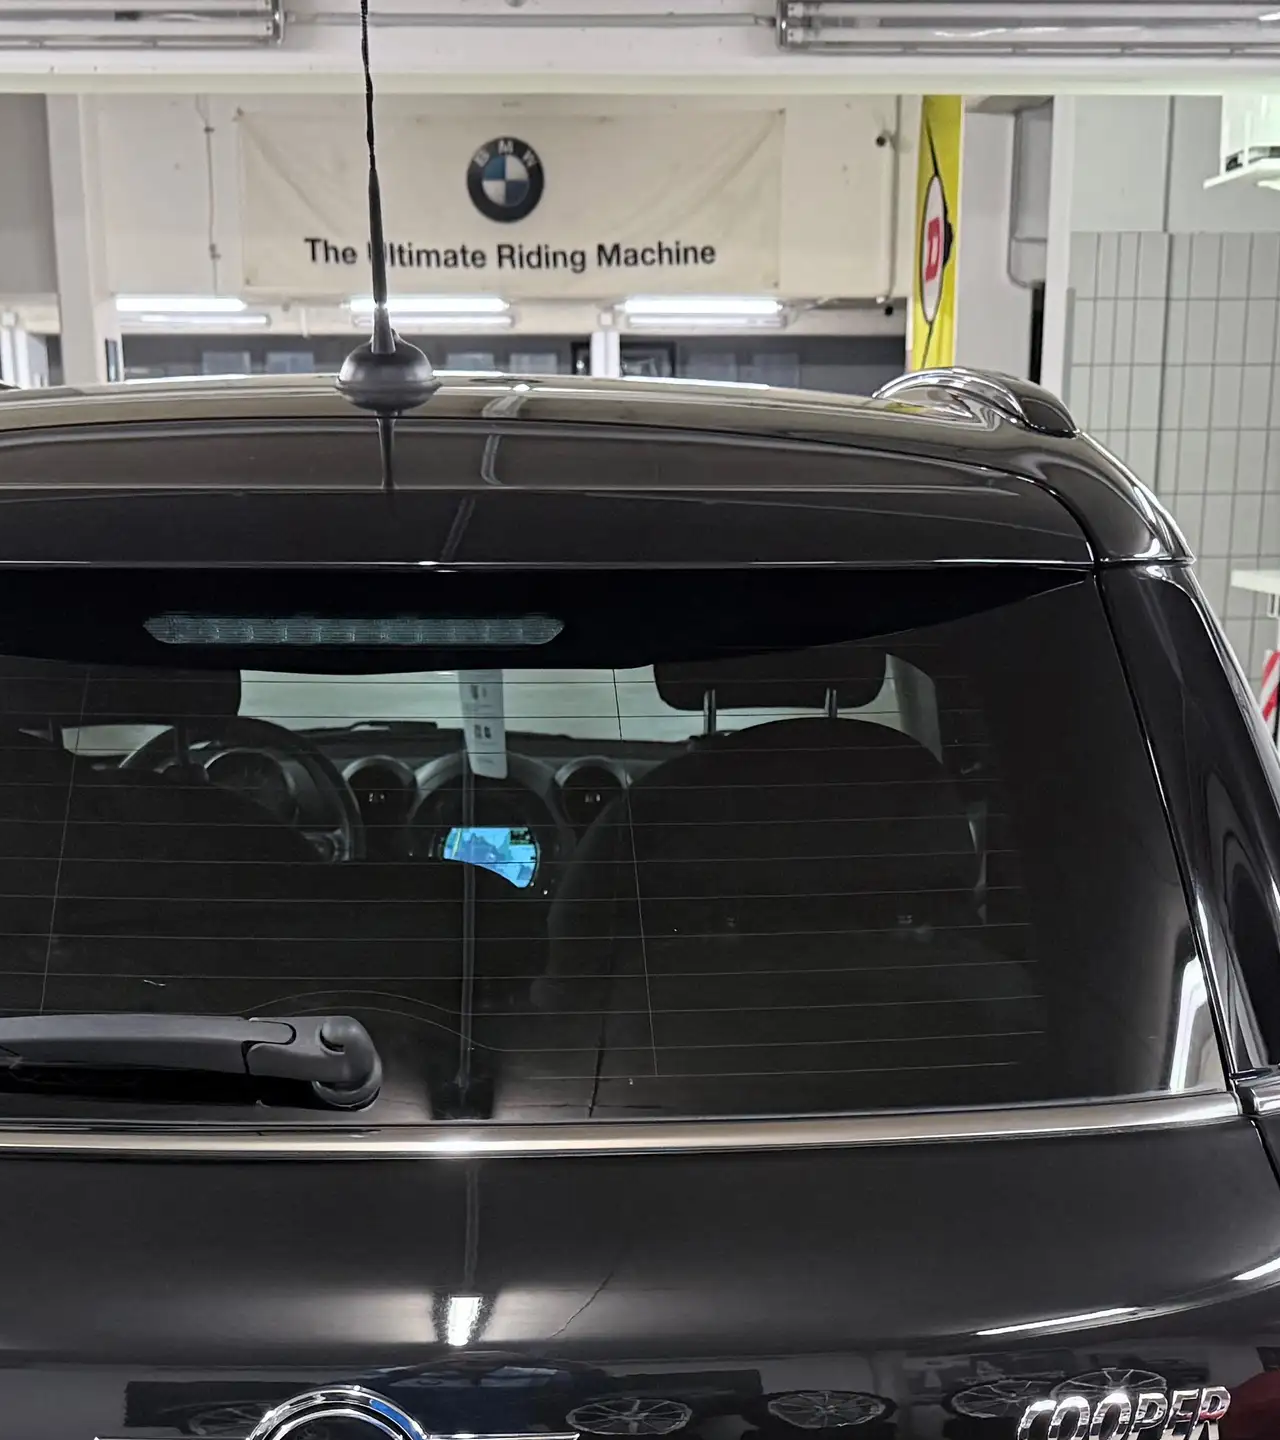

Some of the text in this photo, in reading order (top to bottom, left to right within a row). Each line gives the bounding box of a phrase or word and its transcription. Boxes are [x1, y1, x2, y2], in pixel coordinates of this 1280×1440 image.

[304, 238, 357, 265] The
[497, 243, 586, 273] Riding
[596, 240, 717, 268] Machine
